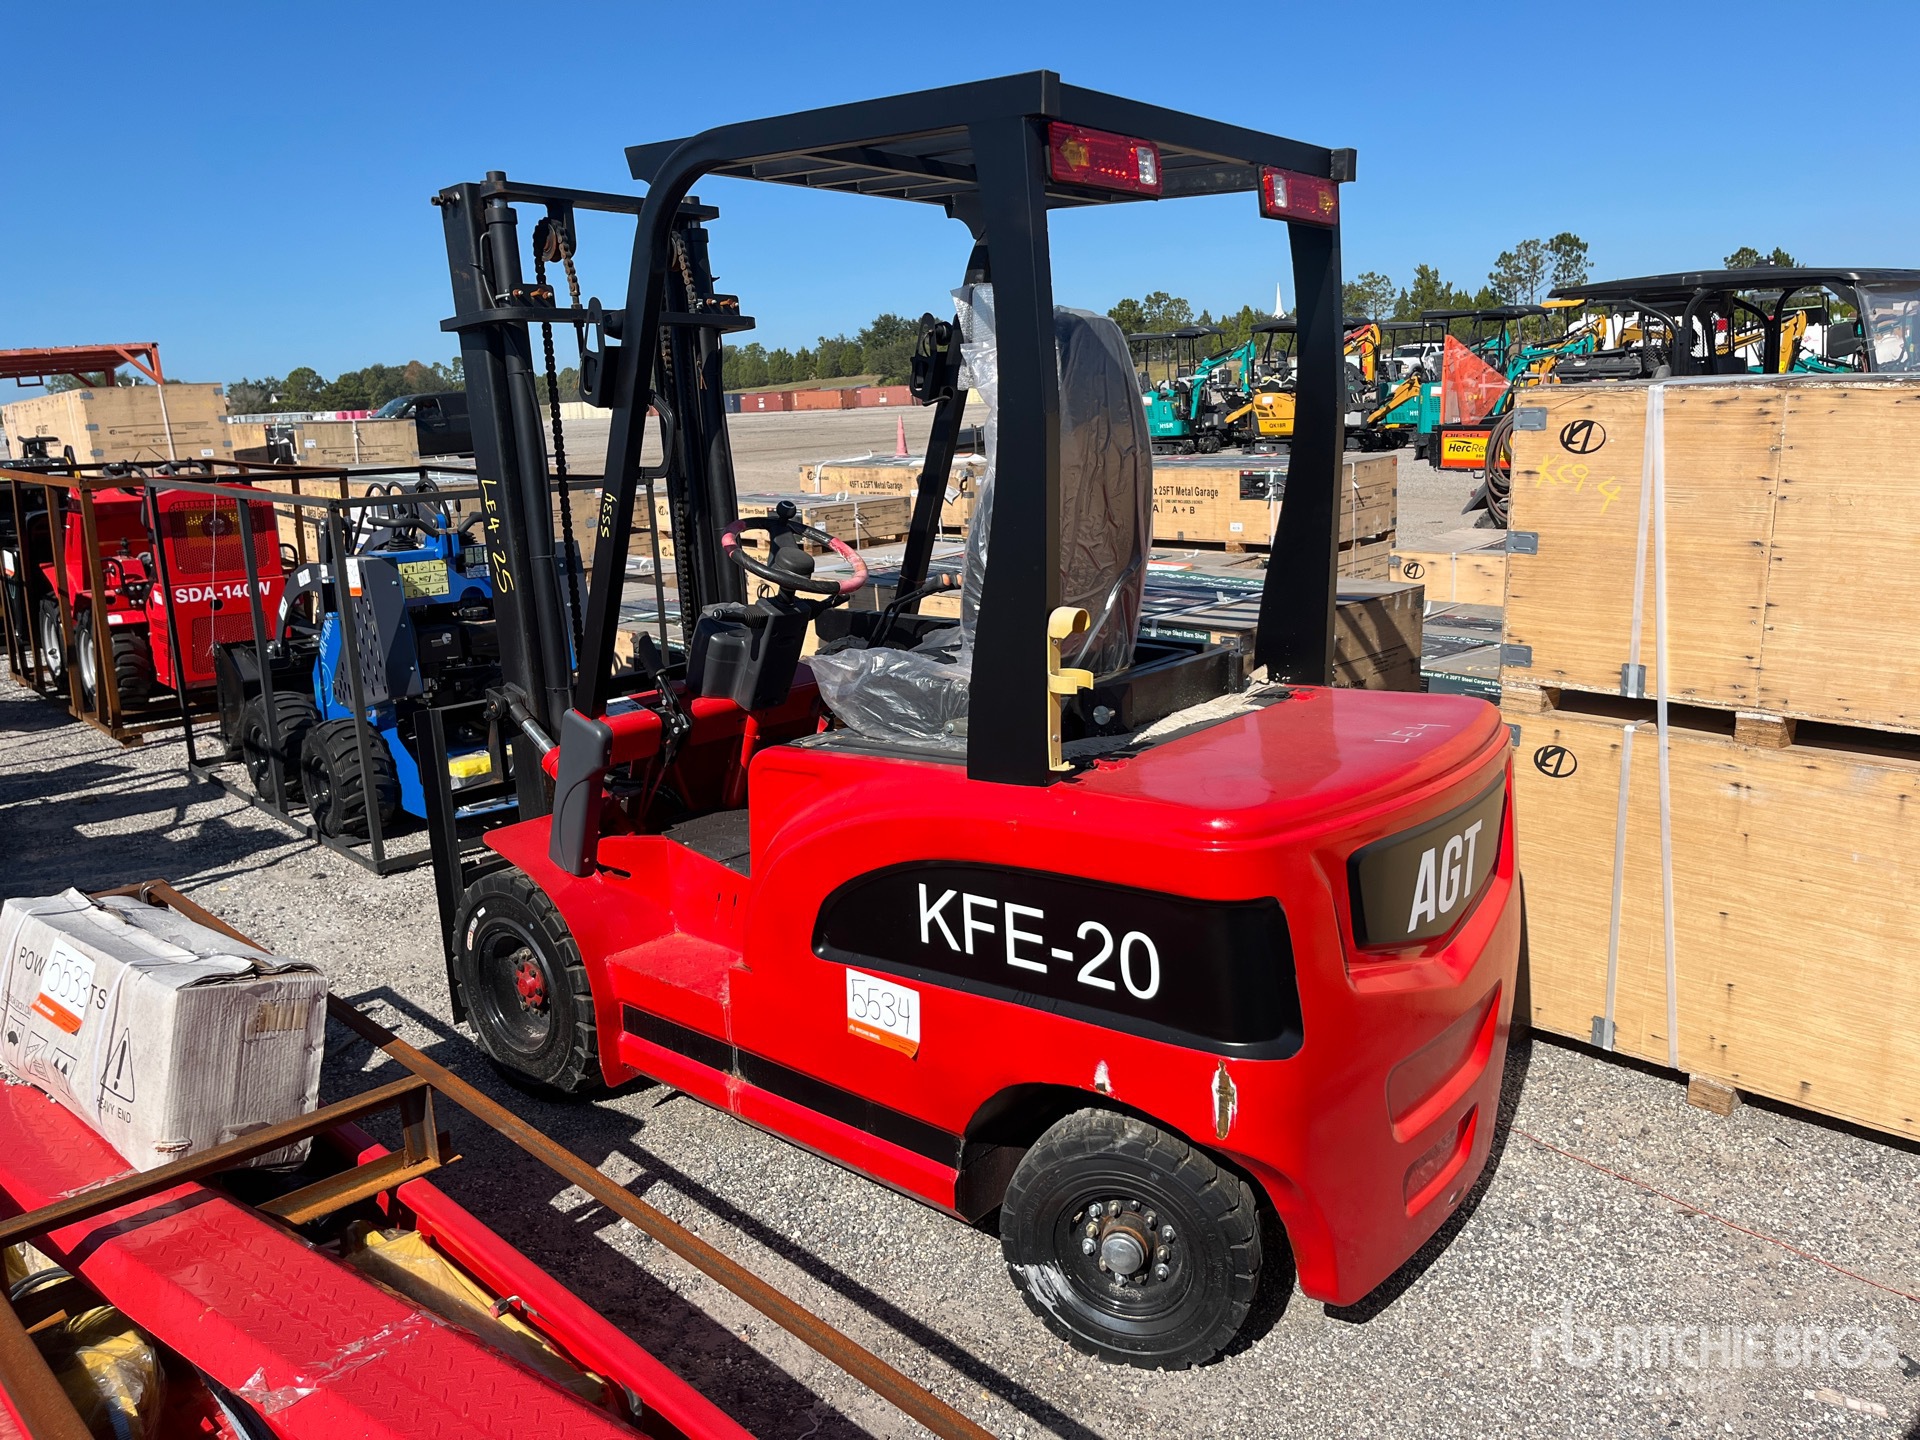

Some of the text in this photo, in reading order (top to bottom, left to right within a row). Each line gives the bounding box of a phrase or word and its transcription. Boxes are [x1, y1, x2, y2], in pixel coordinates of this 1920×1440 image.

[873, 481, 887, 490] Metal
[887, 481, 903, 491] Garage
[1158, 485, 1175, 496] 25FT
[1175, 486, 1194, 496] Metal
[1194, 486, 1219, 499] Garage
[1172, 506, 1178, 514] A
[1189, 506, 1195, 514] B
[1157, 627, 1172, 636] Garage
[1172, 629, 1183, 637] Steel
[1183, 630, 1194, 638] Barn
[1194, 632, 1207, 640] Shed
[1474, 678, 1491, 686] Carport
[1407, 818, 1482, 933] AGT
[918, 882, 1160, 1000] KFE-20
[48, 950, 91, 1008] 5533
[851, 978, 911, 1035] 5534
[117, 1107, 132, 1124] END
